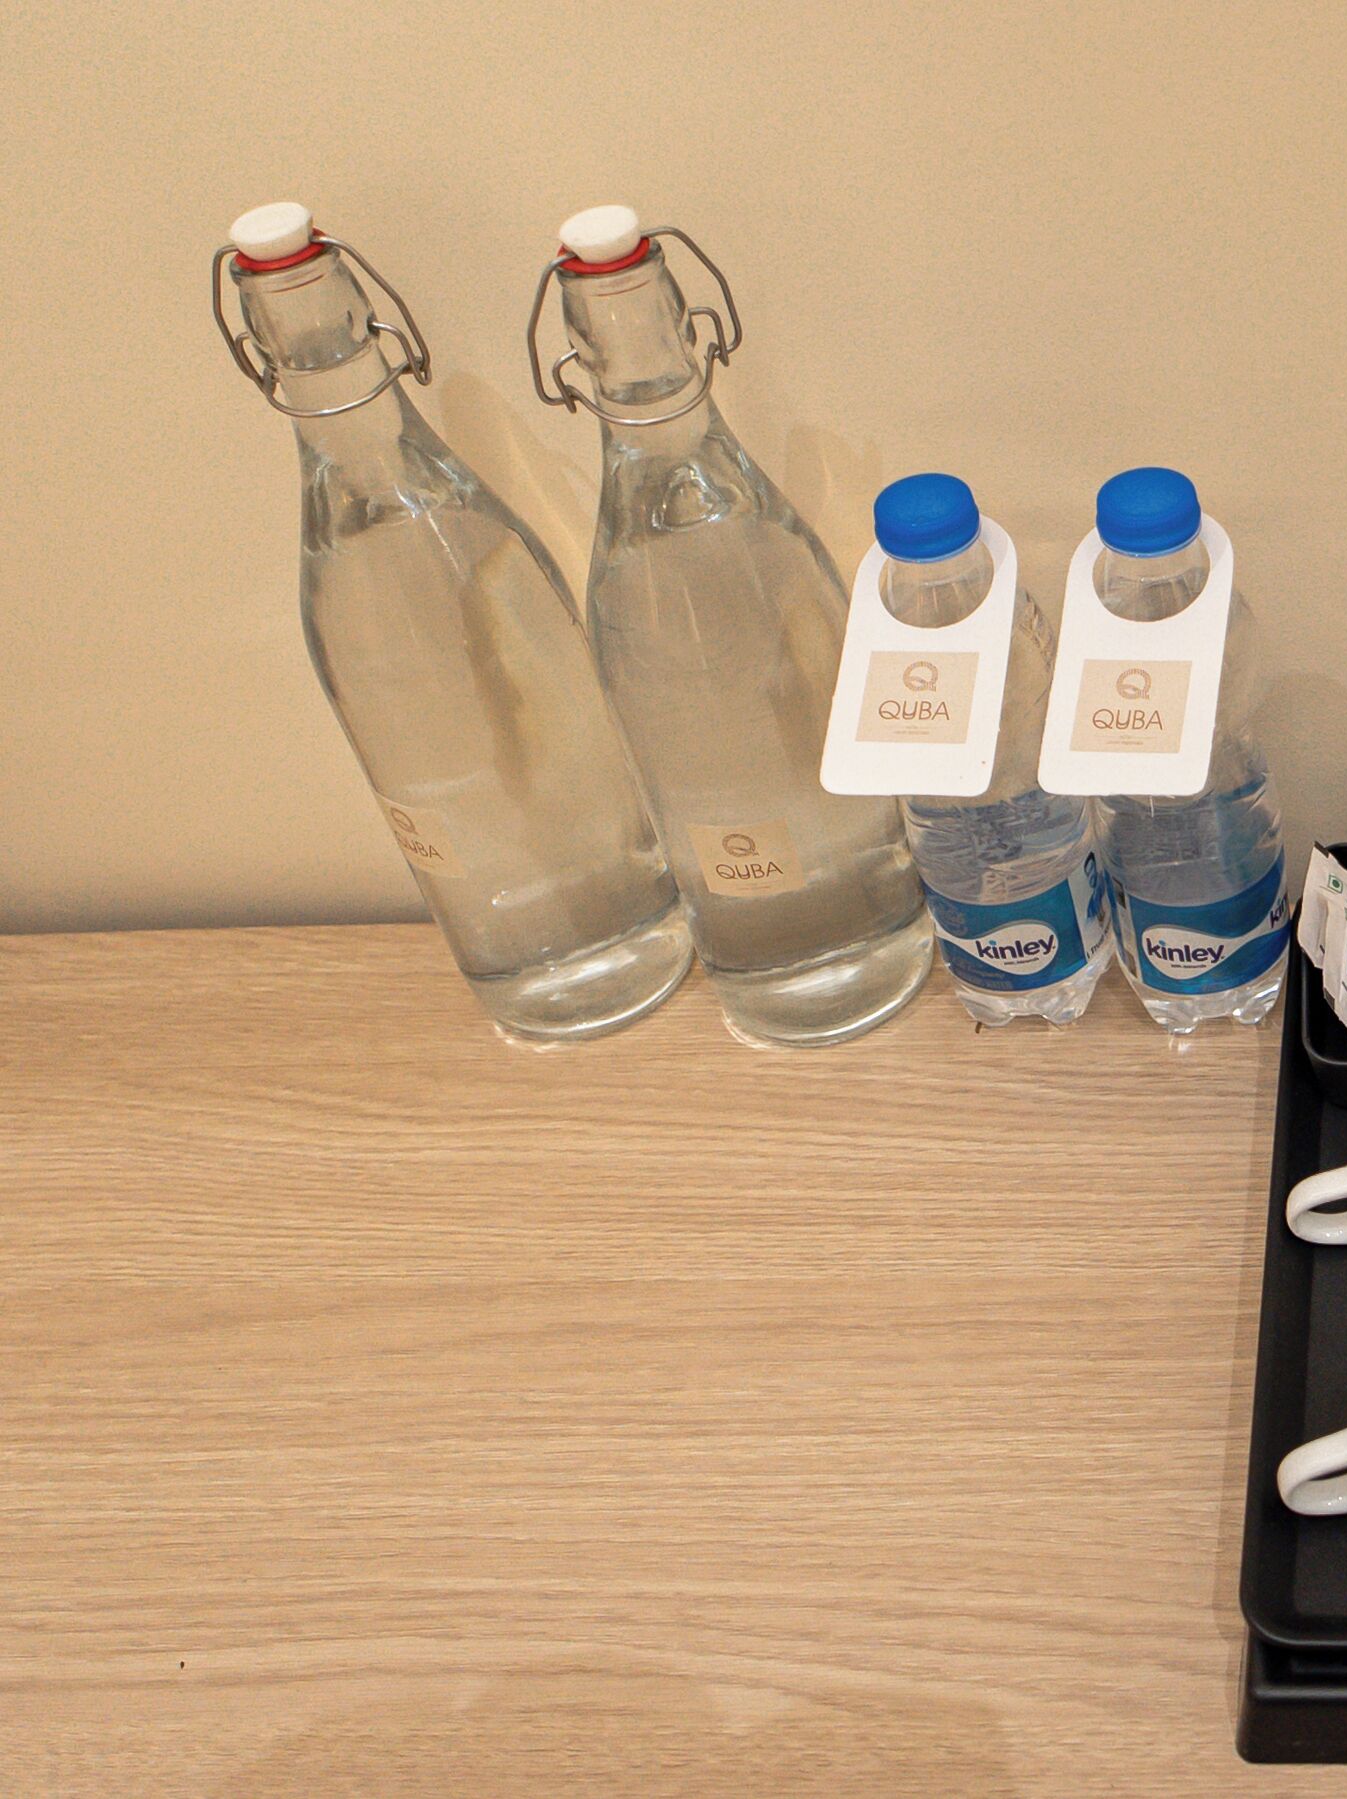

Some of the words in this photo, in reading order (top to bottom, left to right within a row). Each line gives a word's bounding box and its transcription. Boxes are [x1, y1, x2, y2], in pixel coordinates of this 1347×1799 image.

[879, 700, 950, 720] QUBA
[1092, 708, 1163, 730] QUBA
[716, 861, 784, 880] QUBA
[975, 935, 1055, 959] kinley
[1146, 938, 1225, 963] kinley
